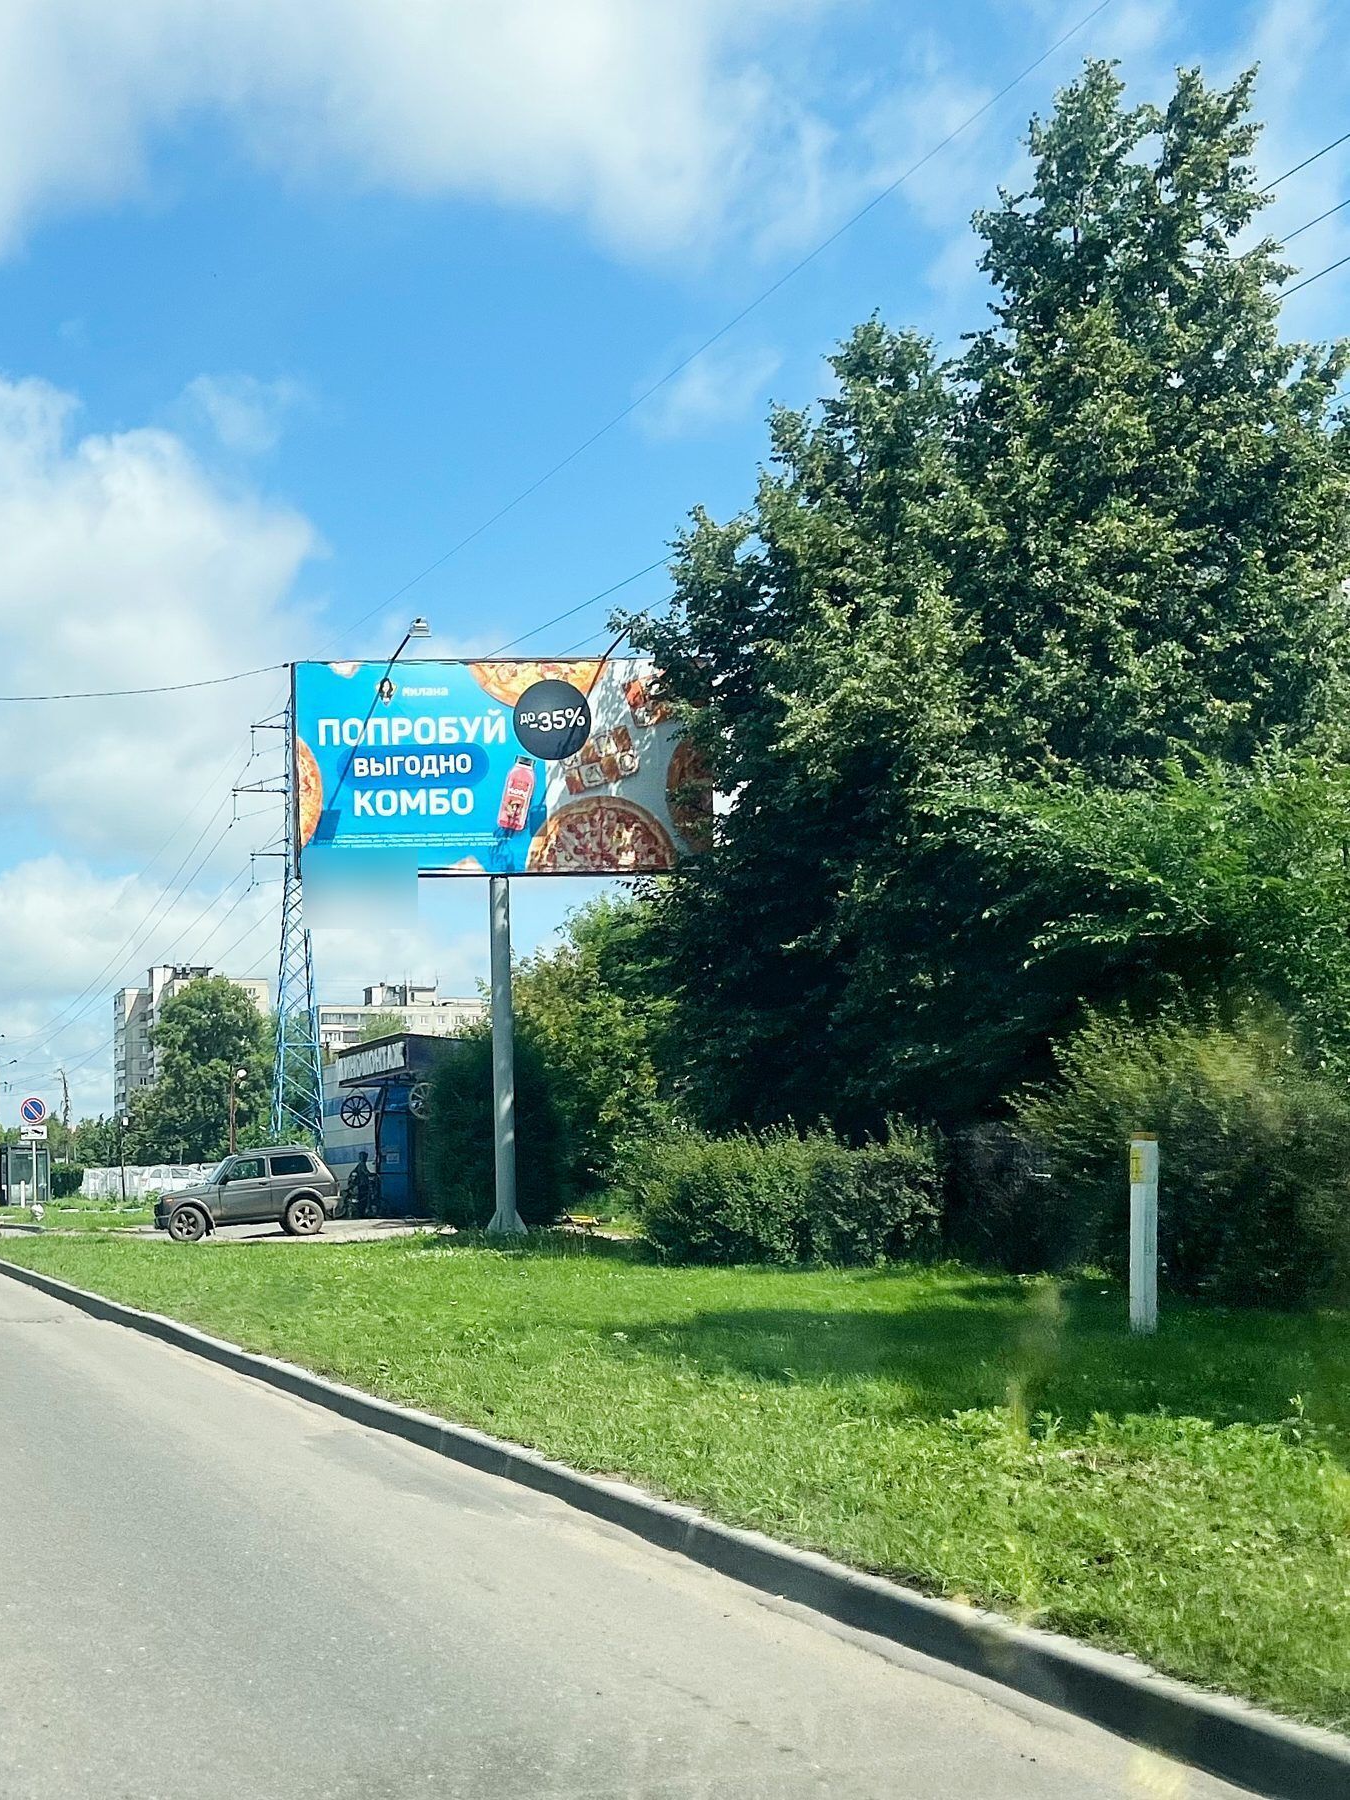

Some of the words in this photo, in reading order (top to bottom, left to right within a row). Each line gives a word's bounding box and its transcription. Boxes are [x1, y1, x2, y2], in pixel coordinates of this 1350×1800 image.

[317, 708, 507, 747] ПОПРОБУЙ
[529, 706, 586, 732] -35%
[353, 753, 473, 778] ВЫГОДНО
[353, 787, 475, 817] КОМБО
